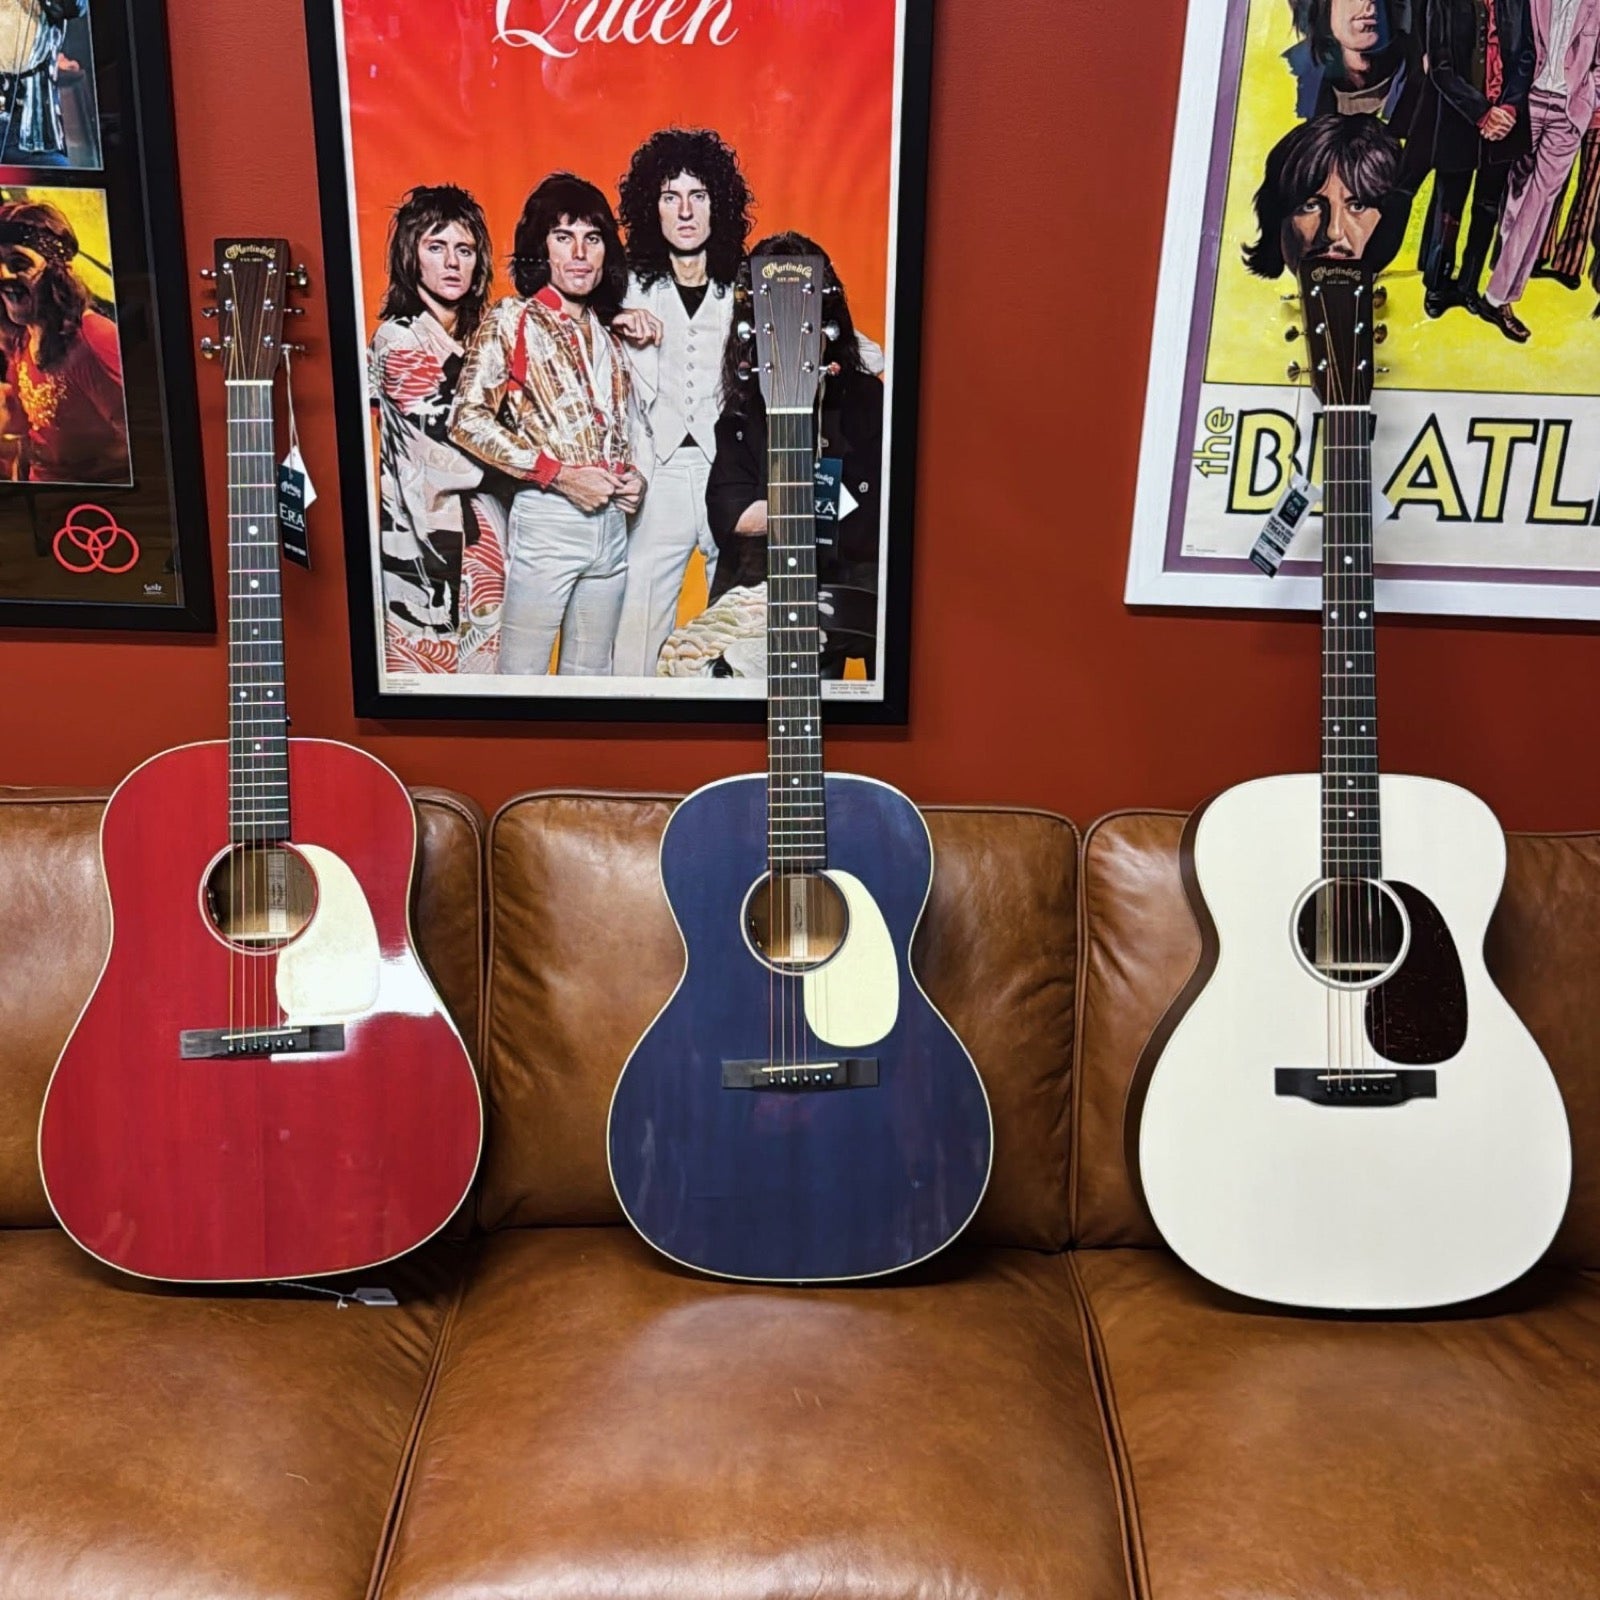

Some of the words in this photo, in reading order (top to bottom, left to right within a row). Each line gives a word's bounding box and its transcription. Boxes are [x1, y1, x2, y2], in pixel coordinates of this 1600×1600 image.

[492, 0, 738, 58] Queen
[1192, 406, 1234, 478] the
[1225, 408, 1600, 526] BATL
[279, 502, 305, 527] ERA
[814, 500, 837, 515] RA
